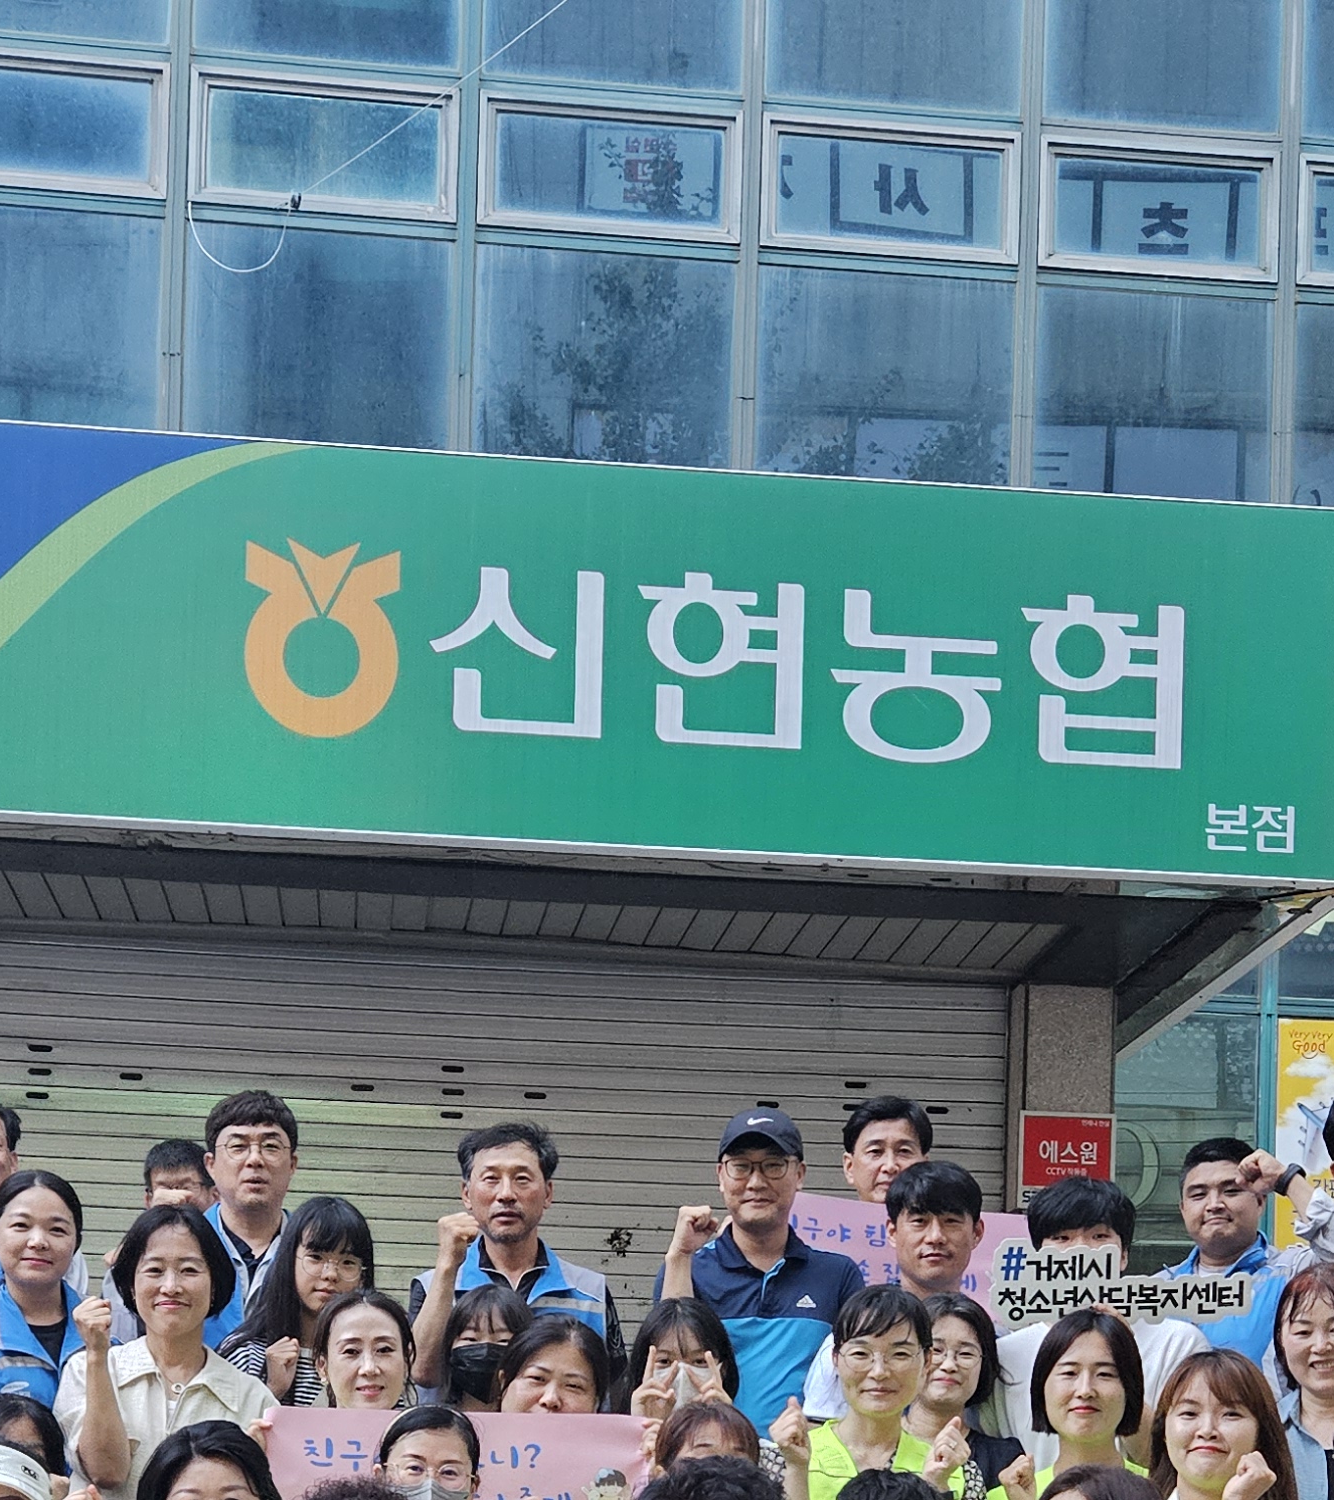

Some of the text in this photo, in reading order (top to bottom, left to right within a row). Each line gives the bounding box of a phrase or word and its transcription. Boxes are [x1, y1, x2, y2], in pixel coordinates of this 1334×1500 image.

[429, 566, 1296, 855] 신현농협 본점
[1038, 1139, 1099, 1166] 에스원
[1045, 1166, 1067, 1176] CCTV
[1000, 1246, 1113, 1282] #거제시
[997, 1279, 1245, 1323] 청소년상담복지센터
